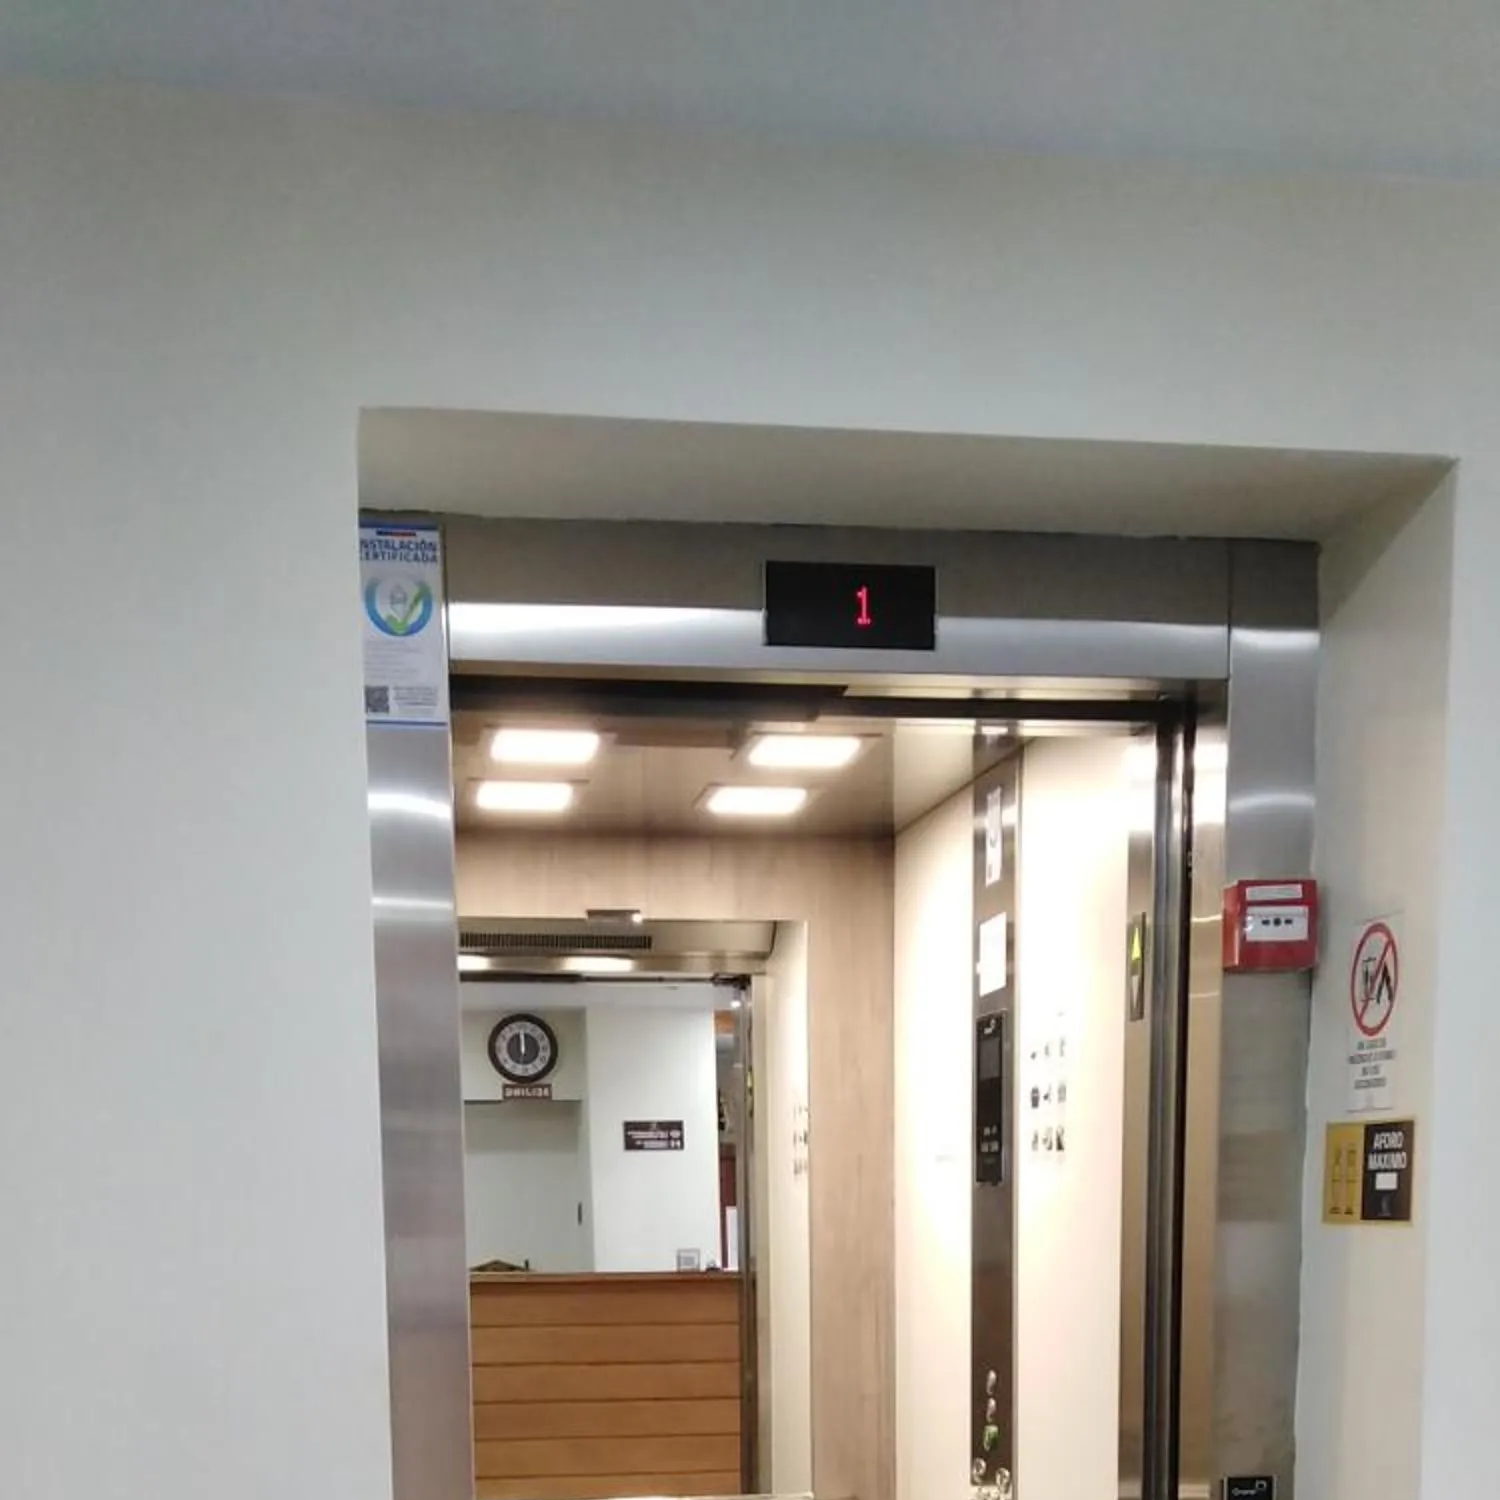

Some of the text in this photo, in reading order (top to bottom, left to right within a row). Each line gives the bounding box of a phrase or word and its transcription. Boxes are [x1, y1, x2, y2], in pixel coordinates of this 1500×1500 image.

[359, 539, 437, 552] NSTALACIÓN
[857, 586, 871, 625] 1
[1373, 1131, 1404, 1150] AFORO
